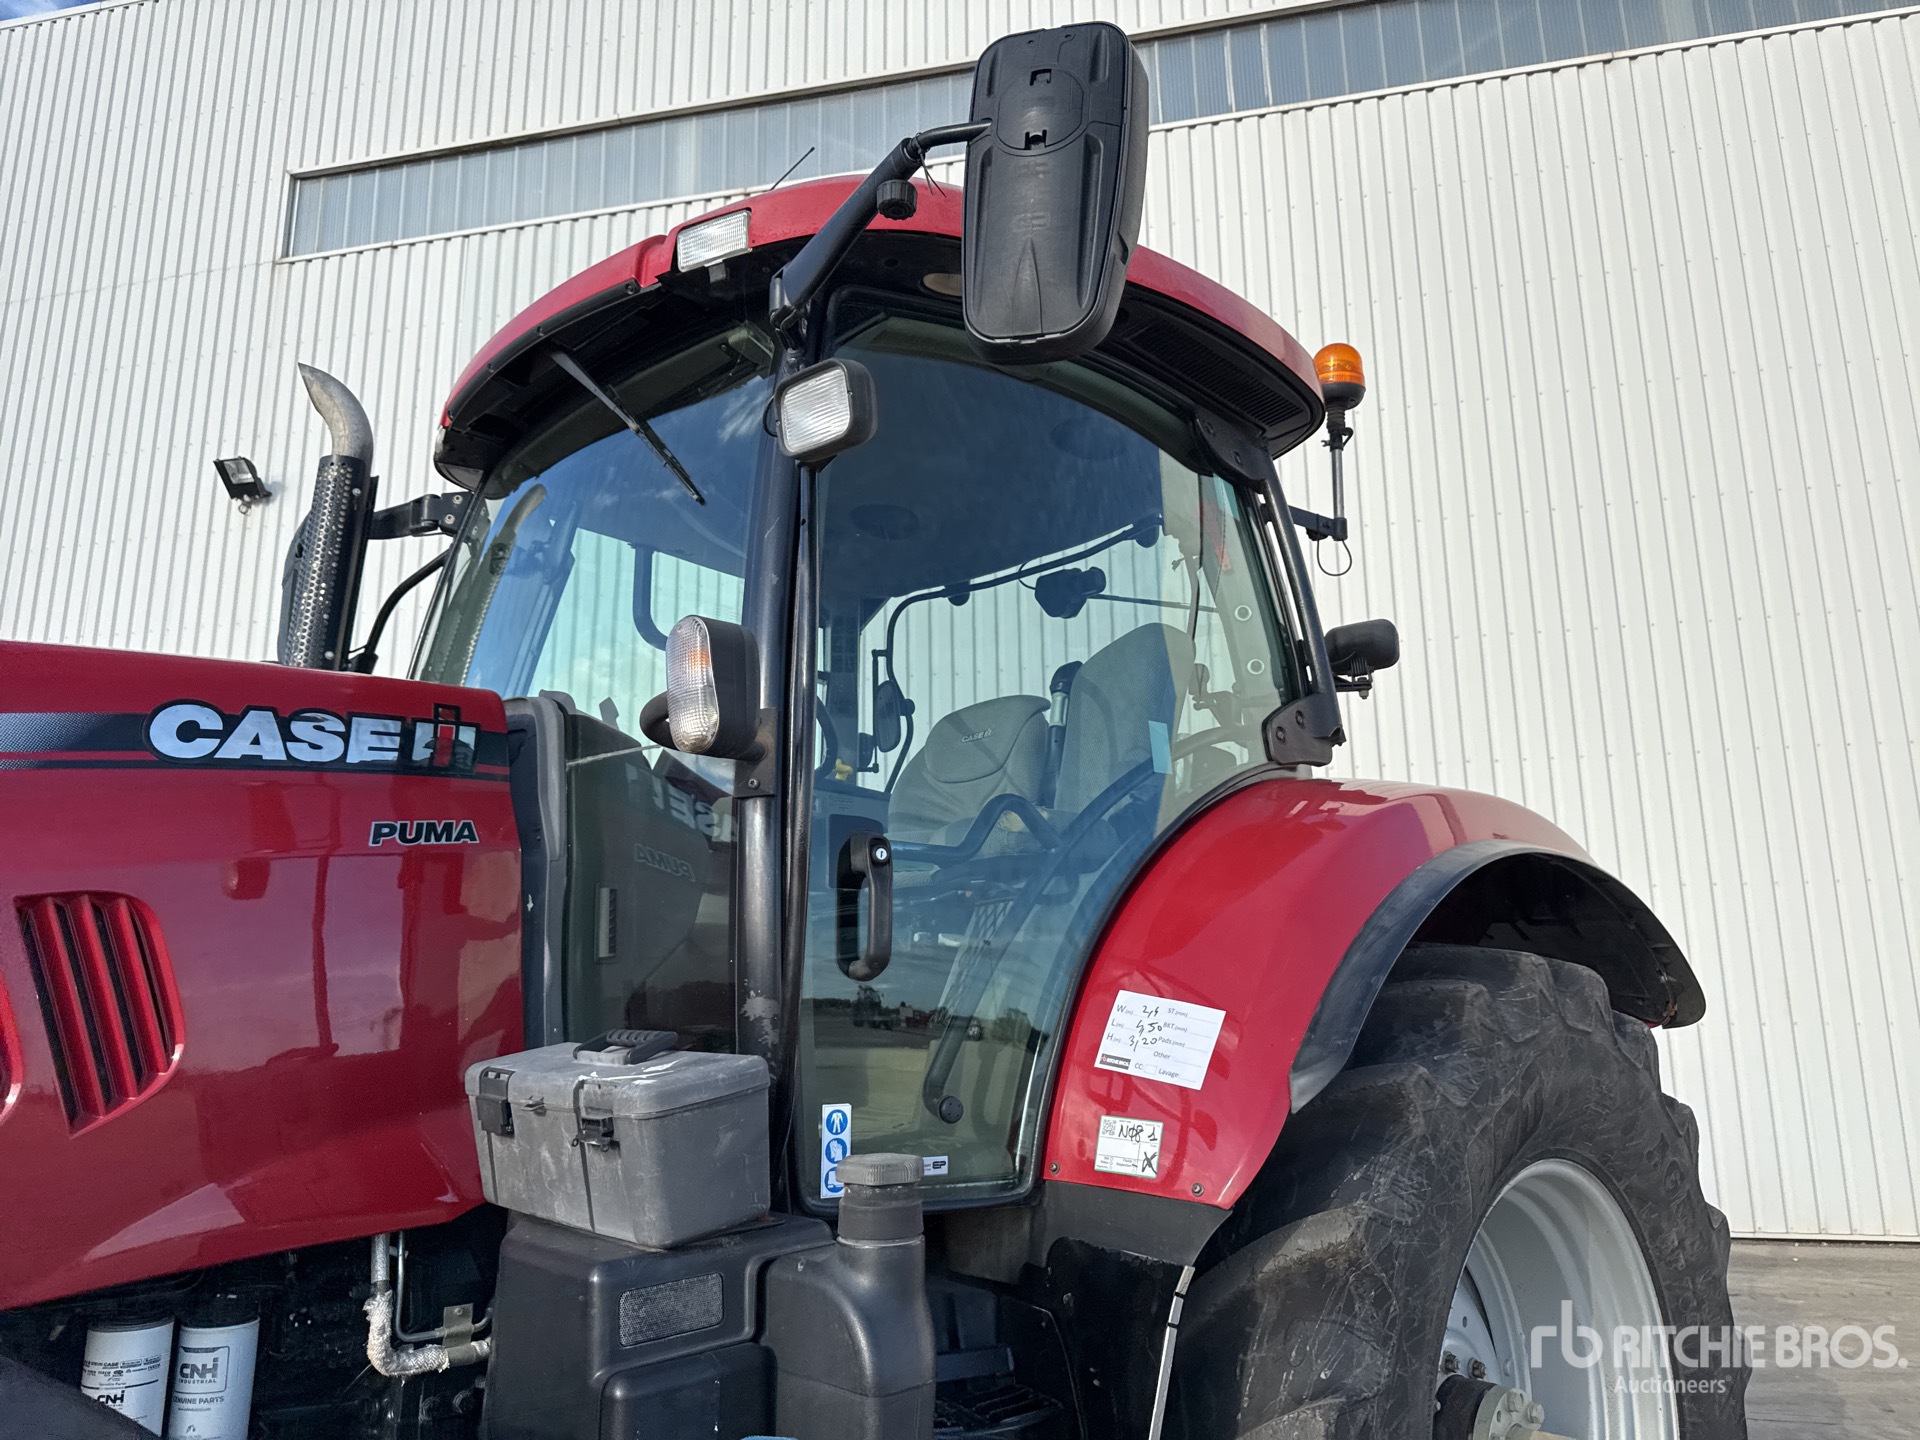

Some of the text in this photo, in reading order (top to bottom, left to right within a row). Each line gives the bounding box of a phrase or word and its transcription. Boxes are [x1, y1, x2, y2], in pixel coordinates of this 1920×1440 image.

[149, 704, 401, 763] CASE
[369, 819, 480, 846] PUMA
[180, 1356, 219, 1379] CNH
[198, 1395, 225, 1405] PARTS
